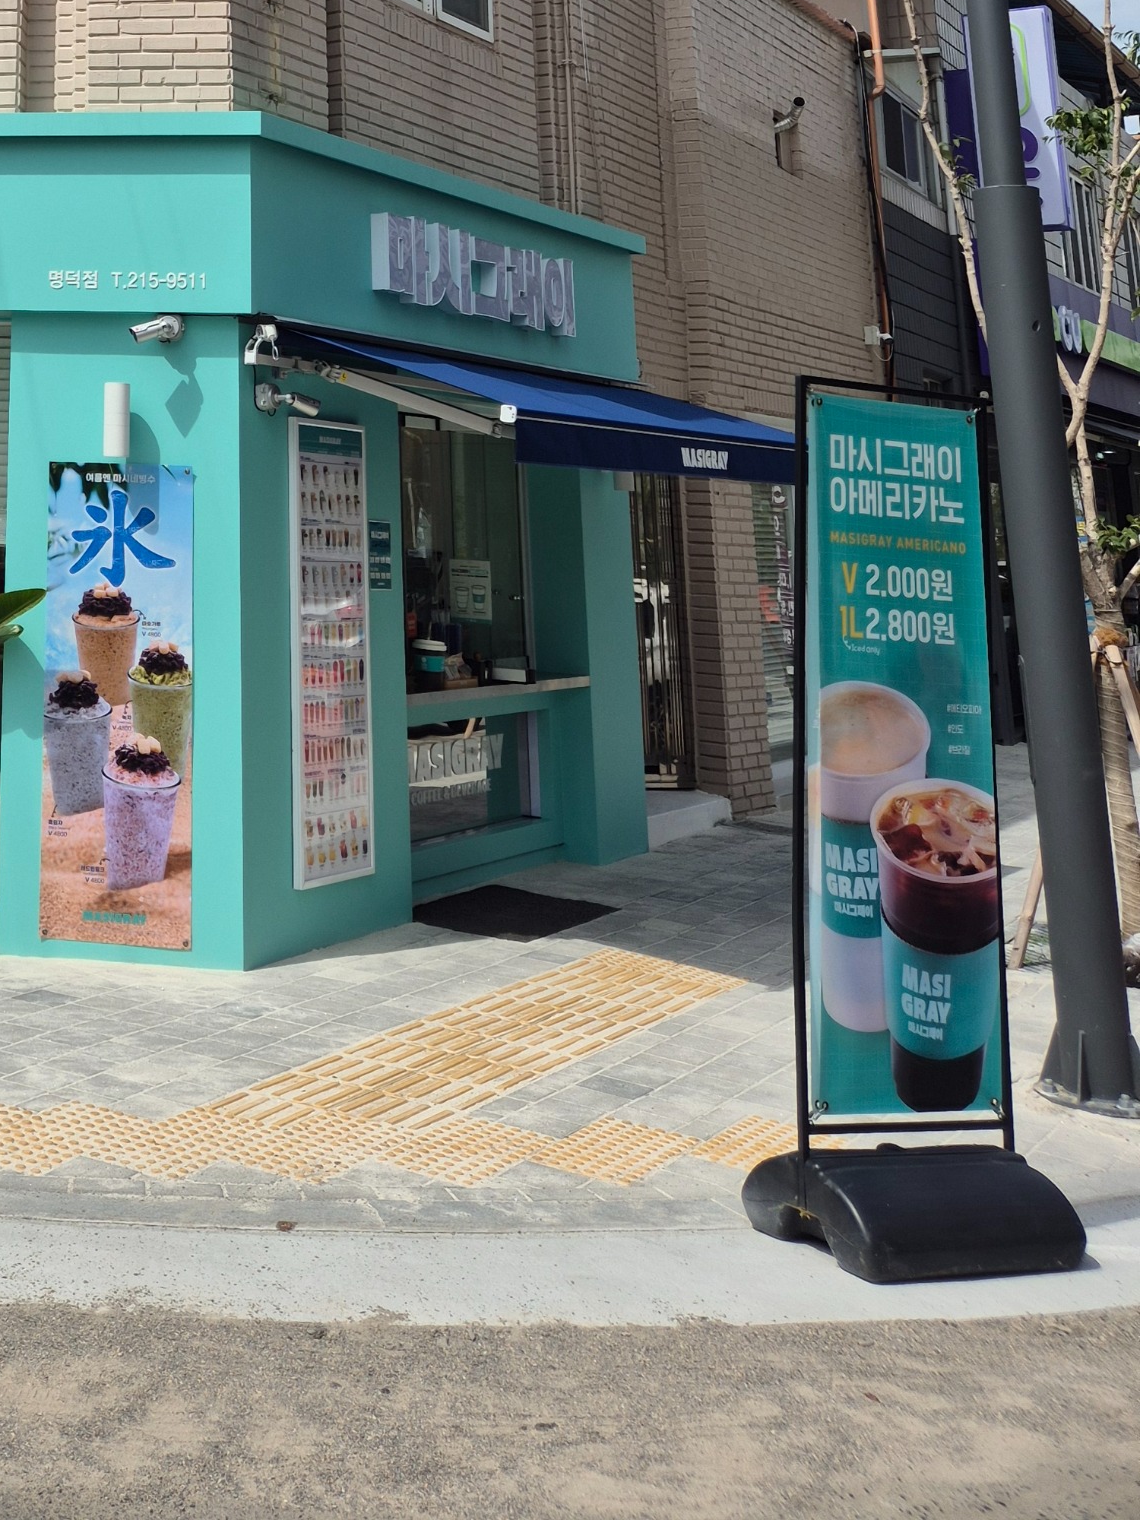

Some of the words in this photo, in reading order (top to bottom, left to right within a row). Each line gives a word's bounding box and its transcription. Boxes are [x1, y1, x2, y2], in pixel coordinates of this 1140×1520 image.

[48, 270, 98, 289] 명덕점
[111, 271, 207, 290] T.215-9511
[371, 211, 576, 338] 마시그래이
[680, 446, 729, 471] MASIGRAY
[829, 433, 962, 484] 마시그래이
[830, 476, 965, 525] 아메리카노
[829, 530, 893, 548] MASIGRAY
[896, 536, 967, 555] AMERICANO
[841, 561, 859, 595] V
[865, 563, 954, 602] 2.000원
[839, 605, 864, 639] 1L
[865, 607, 956, 645] 2.800원
[825, 841, 879, 874] MASI
[826, 872, 880, 901] GRAY
[901, 963, 952, 999] MASI
[900, 993, 952, 1025] GRAY
